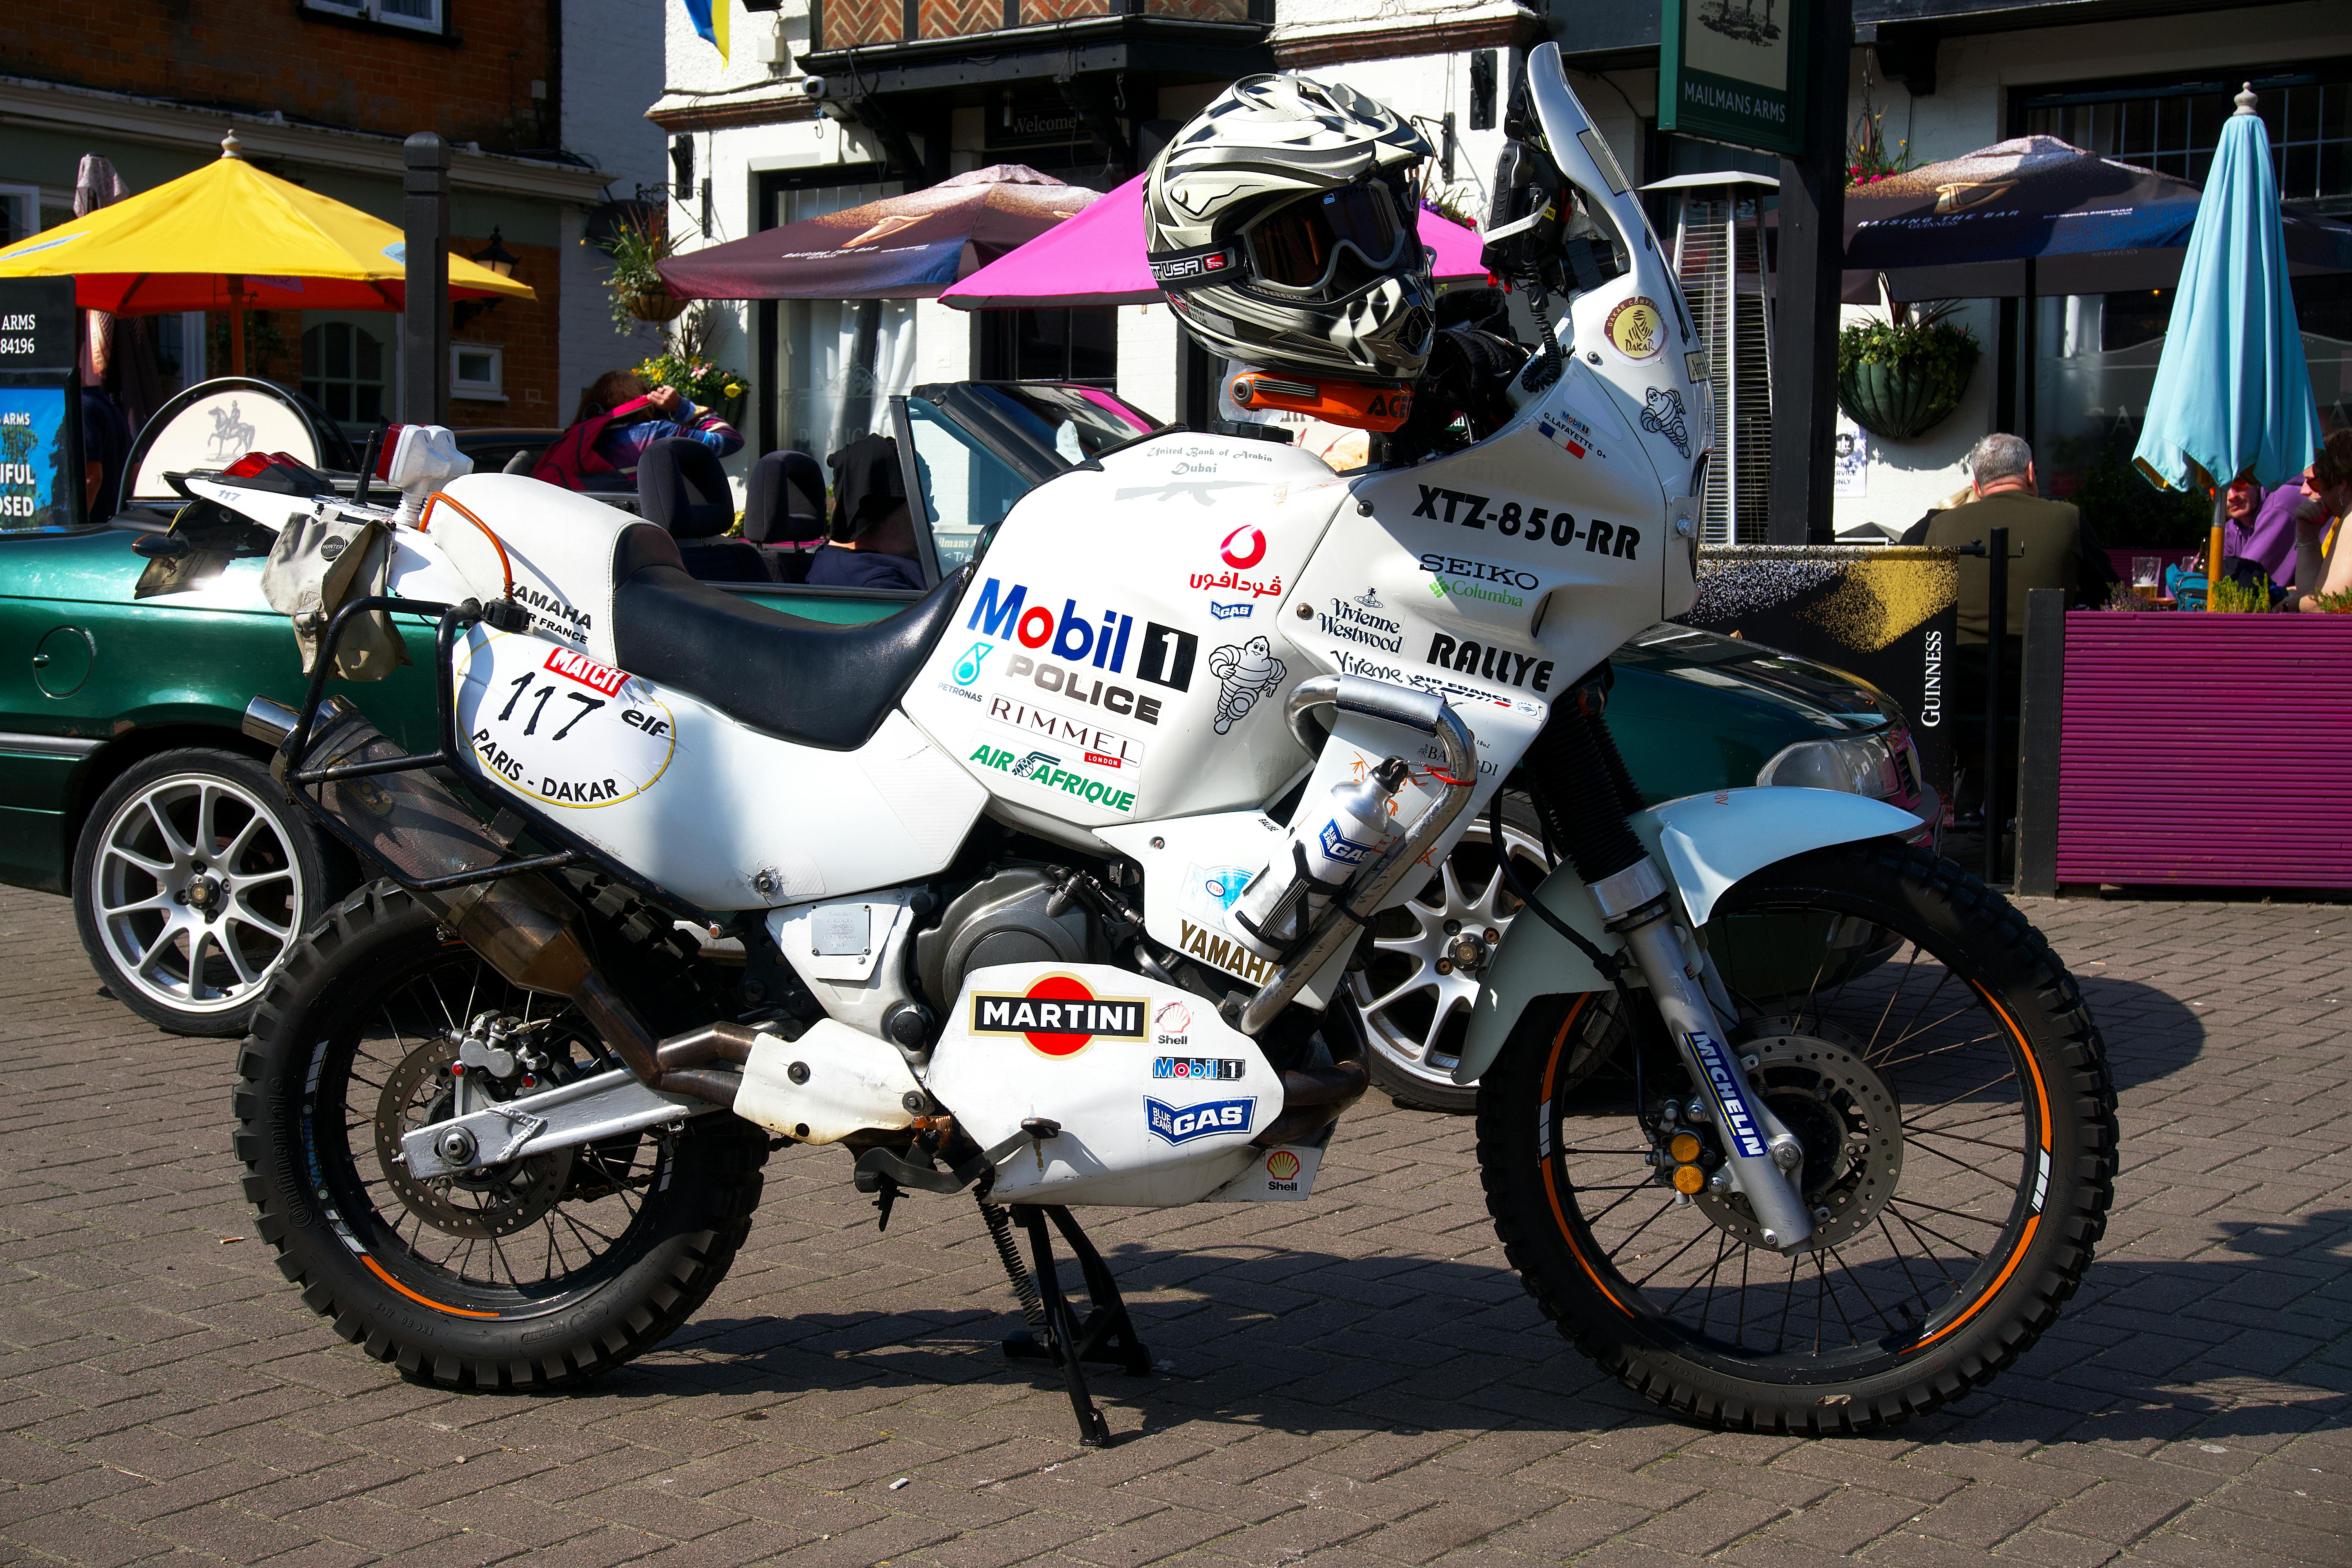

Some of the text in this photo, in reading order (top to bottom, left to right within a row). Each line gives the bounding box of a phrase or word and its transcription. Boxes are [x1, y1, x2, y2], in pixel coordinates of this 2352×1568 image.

[1685, 81, 1786, 123] MAILMANS ARMS
[1013, 114, 1076, 133] Welcome
[1858, 217, 1932, 227] RAISING
[1908, 221, 1958, 229] GUINNESS
[1163, 260, 1199, 277] USA
[1, 314, 36, 330] ARMS
[1608, 304, 1626, 327] DAKAR
[0, 338, 35, 354] 84196
[1625, 338, 1656, 352] DAKAR
[3, 412, 30, 426] ARMS
[1562, 411, 1581, 429] Mobil
[1544, 412, 1593, 450] G.LAFAYETTE
[1147, 446, 1182, 457] United
[1186, 447, 1214, 457] Bank
[1233, 450, 1272, 462] Arabia
[1171, 462, 1217, 475] Dubai
[218, 490, 241, 501] 117
[1412, 483, 1641, 561] XTZ-850-RR
[1419, 554, 1539, 590] SEIKO
[1452, 579, 1523, 609] Columbia
[1220, 606, 1249, 617] GAS
[1330, 598, 1400, 634] Vivienne
[539, 618, 588, 644] FRANCE
[966, 577, 1133, 674] Mobil
[1316, 612, 1403, 653] Westwood
[550, 648, 626, 692] MATCH
[1426, 632, 1555, 693] RALLYE
[1005, 653, 1163, 726] POLICE
[1413, 675, 1512, 704] AIR FRANCE
[1921, 630, 1942, 727] GUINNESS
[938, 682, 983, 702] PETRONAS
[498, 671, 605, 740] 117
[621, 709, 670, 737] elf
[991, 697, 1137, 764] RIMMEL
[1088, 755, 1119, 766] LONDON
[1417, 743, 1429, 758] Ron
[472, 728, 524, 782] PARIS
[541, 777, 620, 802] DAKAR
[969, 744, 1136, 813] AIR AFRIQUE
[1258, 818, 1279, 833] BALISE
[1328, 826, 1338, 844] BLUE
[1323, 831, 1333, 849] JEANS
[983, 1001, 1135, 1031] MARTINI
[1158, 1034, 1187, 1045] Shell
[1154, 1058, 1218, 1079] Mobil
[1693, 1034, 1764, 1155] MICHELIN
[1151, 1114, 1172, 1136] JEANS
[1152, 1106, 1171, 1124] BLUE
[1174, 1105, 1243, 1136] GAS
[267, 1094, 312, 1228] Continental
[304, 1116, 323, 1187] YAMAHA
[1267, 1181, 1298, 1192] Shell
